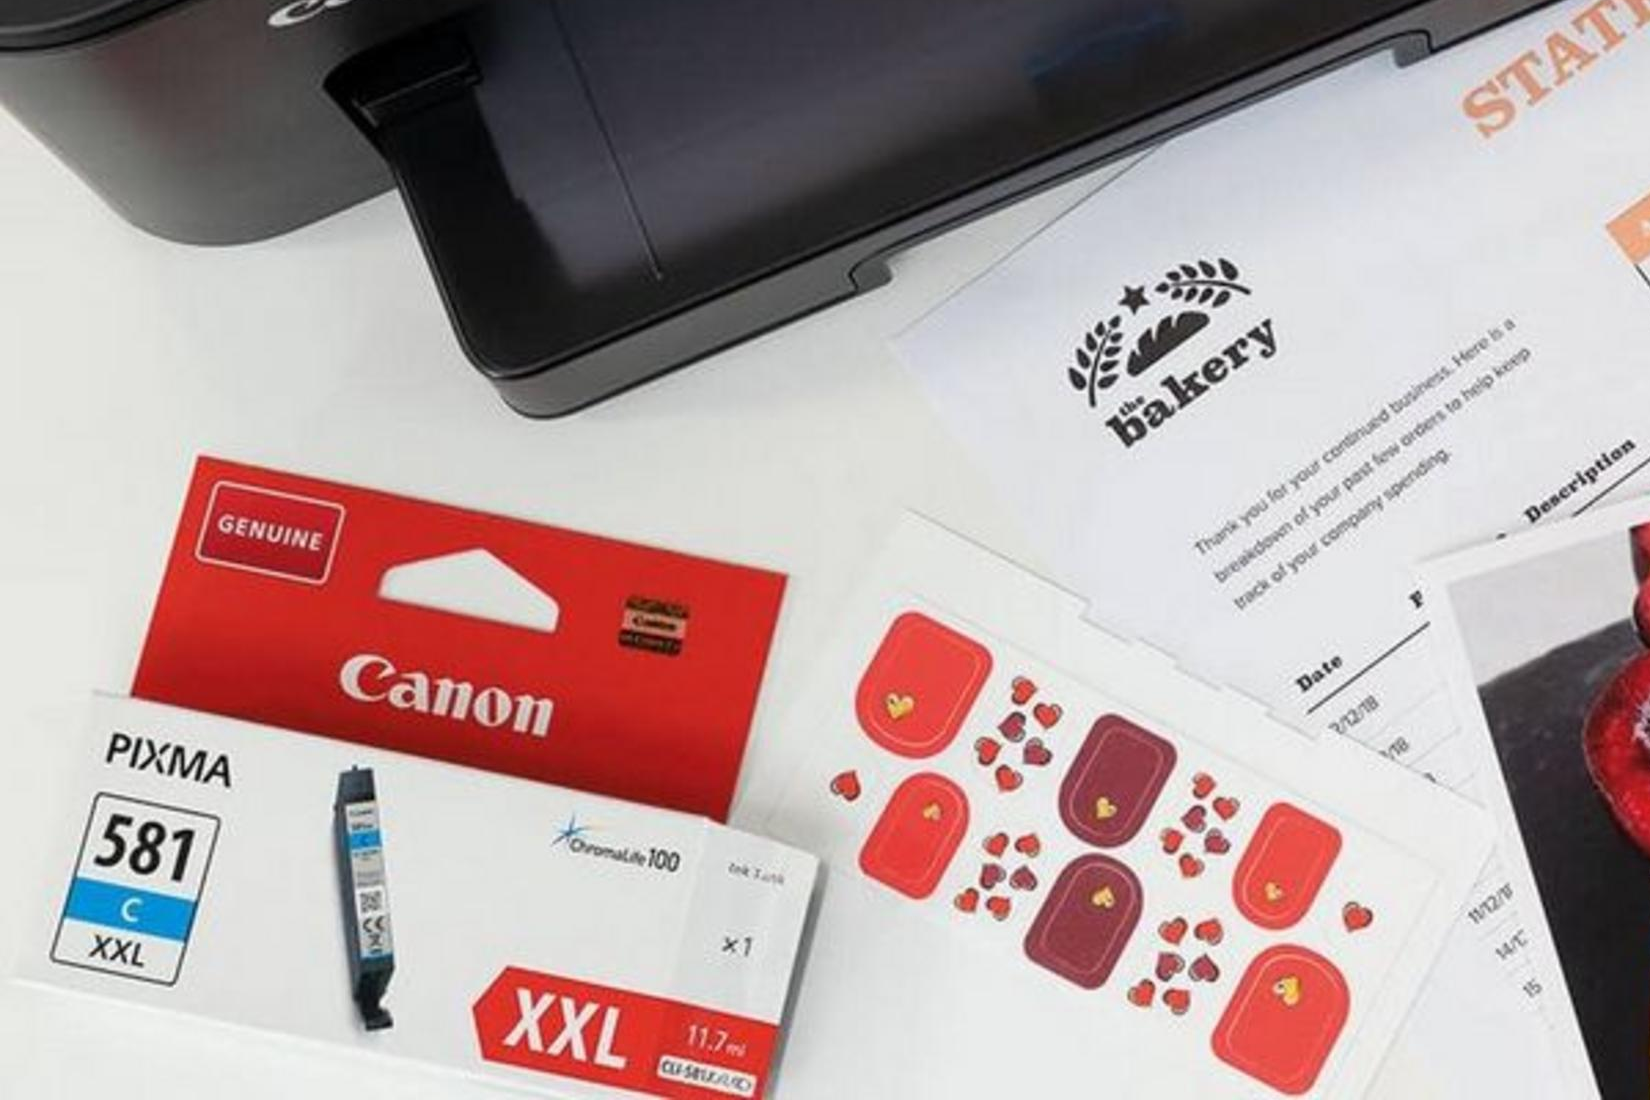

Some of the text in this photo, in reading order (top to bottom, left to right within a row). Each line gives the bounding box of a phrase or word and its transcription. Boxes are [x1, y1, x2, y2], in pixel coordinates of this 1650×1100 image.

[1105, 318, 1277, 448] bakery
[1119, 396, 1145, 417] the
[1194, 318, 1516, 555] Thank you for your continued business. Here is a
[1213, 348, 1531, 584] breakdown of your past few orders to help keep
[1523, 438, 1637, 524] Description
[217, 513, 325, 552] GENUINE
[1233, 449, 1451, 610] track of your company spending.
[339, 654, 556, 738] Canon
[1296, 655, 1343, 692] Date
[106, 733, 232, 788] PIXMA
[94, 813, 195, 882] 581
[121, 897, 143, 923] C
[89, 934, 144, 966] XXL
[502, 986, 631, 1071] XXL
